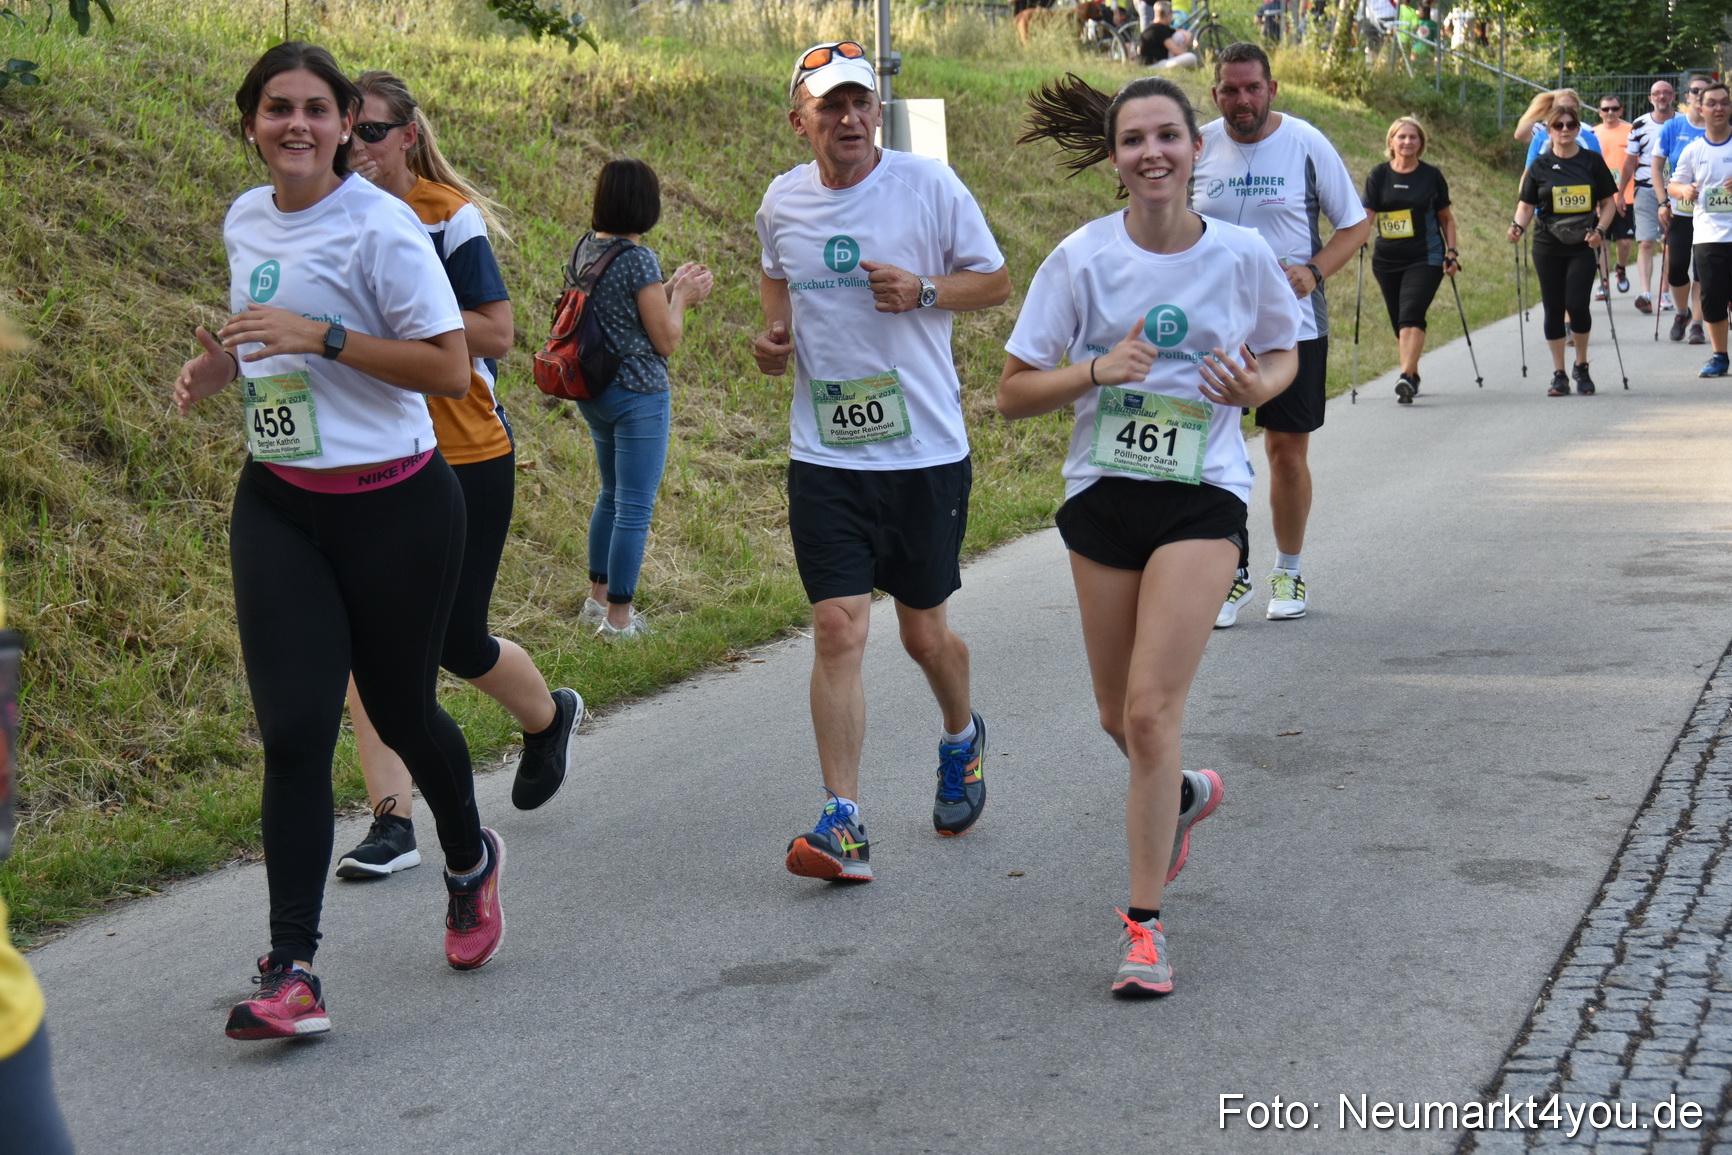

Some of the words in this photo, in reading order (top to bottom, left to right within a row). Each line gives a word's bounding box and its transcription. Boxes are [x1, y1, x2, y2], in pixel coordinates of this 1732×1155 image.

[1228, 176, 1285, 187] HAUBNER
[1235, 187, 1278, 197] TREPPEN
[1558, 195, 1586, 206] 1999
[1383, 220, 1406, 231] 1967
[879, 389, 896, 398] 2019
[832, 400, 884, 428] 460
[254, 406, 296, 438] 458
[1181, 421, 1202, 431] 2019
[830, 428, 860, 437] Pöllinger
[862, 421, 894, 433] Reinhold
[276, 437, 300, 446] Kathrin
[1116, 420, 1178, 457] 461
[1114, 448, 1151, 463] Pöllinger
[1153, 455, 1178, 467] Sarah
[358, 465, 399, 487] NIKE
[401, 452, 425, 473] PRO
[1114, 457, 1149, 469] Datenschutz
[1150, 464, 1175, 474] Pöllinger
